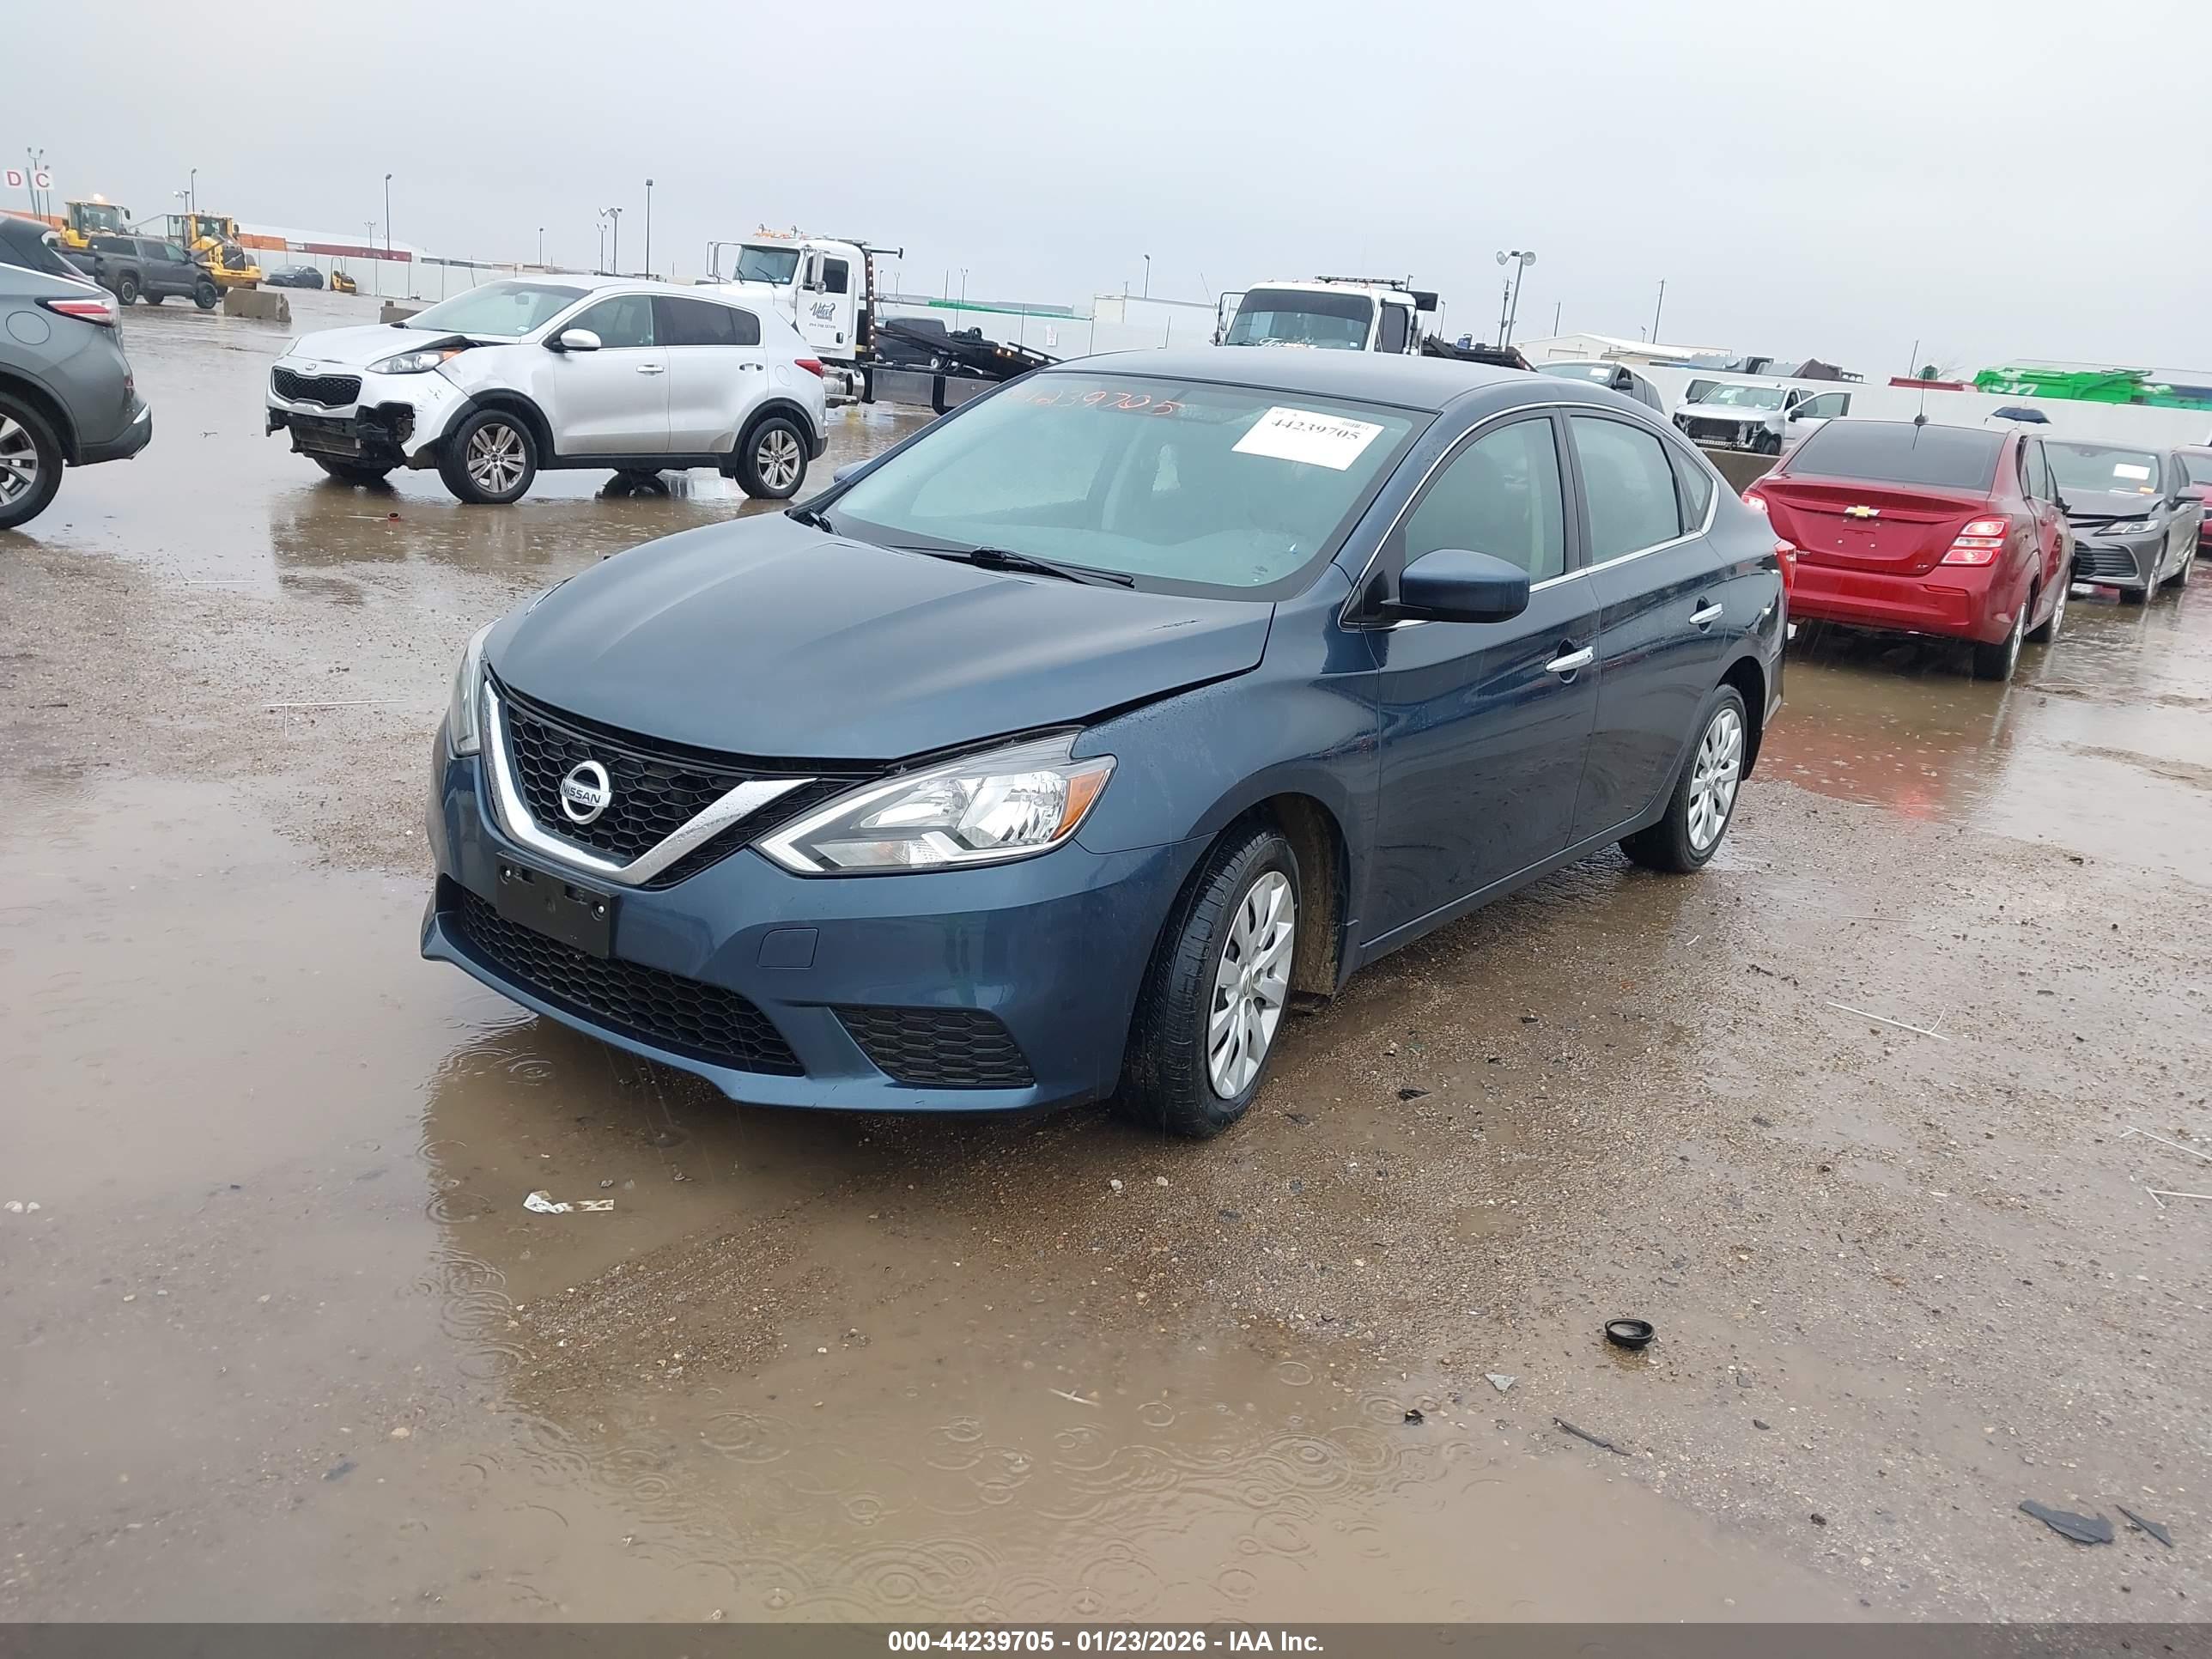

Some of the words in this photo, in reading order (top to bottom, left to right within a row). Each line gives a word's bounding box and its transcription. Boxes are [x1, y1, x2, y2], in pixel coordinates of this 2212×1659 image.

[6, 170, 22, 186] D
[35, 173, 51, 188] C
[1271, 418, 1362, 441] 44239705
[562, 781, 602, 805] NISSAN
